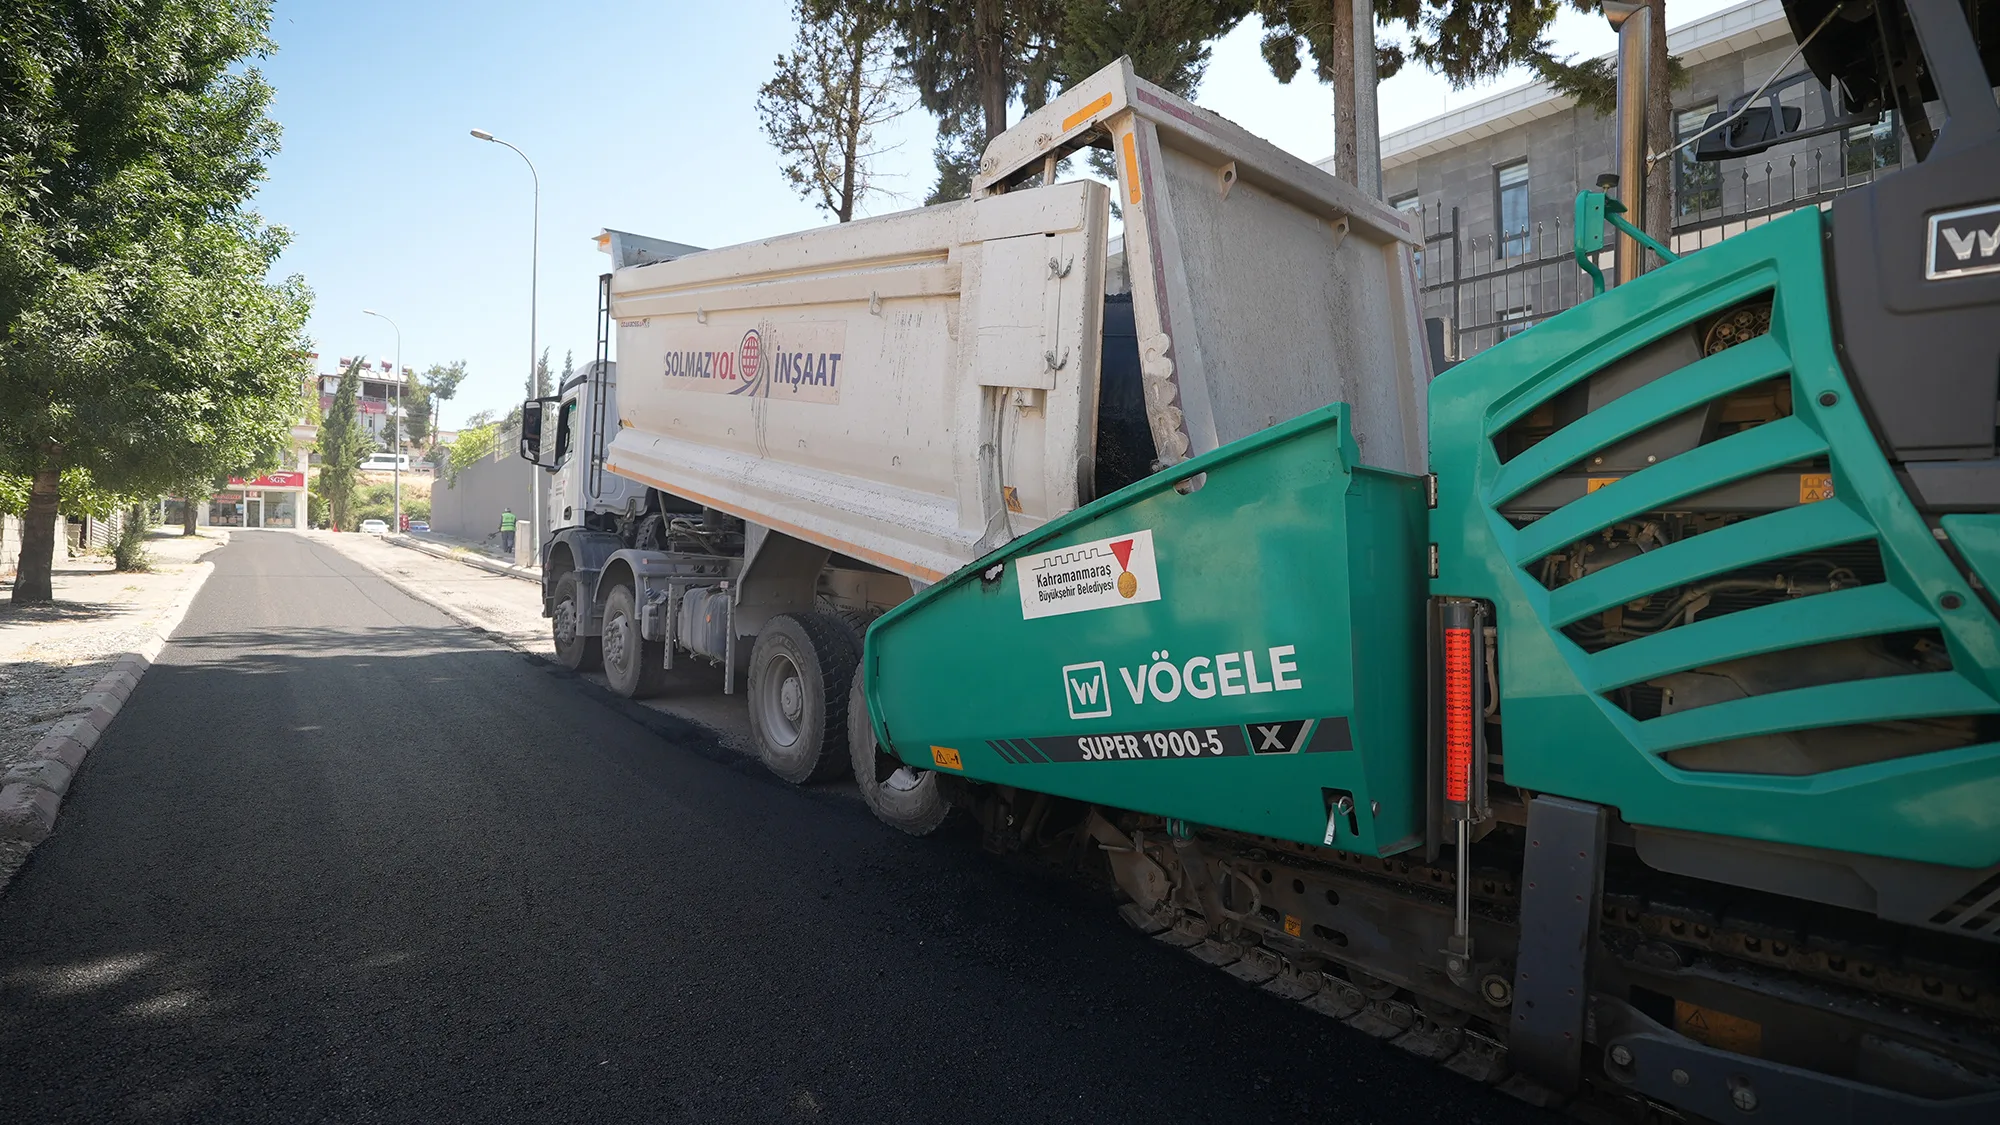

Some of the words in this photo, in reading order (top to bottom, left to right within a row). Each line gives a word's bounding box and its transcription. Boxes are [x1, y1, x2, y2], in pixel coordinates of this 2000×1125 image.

[664, 351, 736, 380] SOLMAZYOL
[774, 345, 842, 393] İNŞAAT
[269, 476, 286, 484] SGK
[1036, 564, 1112, 588] Kahramanmaraş
[1038, 586, 1076, 603] Büyükşehir
[1077, 578, 1115, 596] Belediyesi
[1119, 644, 1302, 705] VÖGELE
[1078, 734, 1143, 761] SUPER
[1143, 729, 1224, 758] 1900-5
[1257, 724, 1286, 750] X
